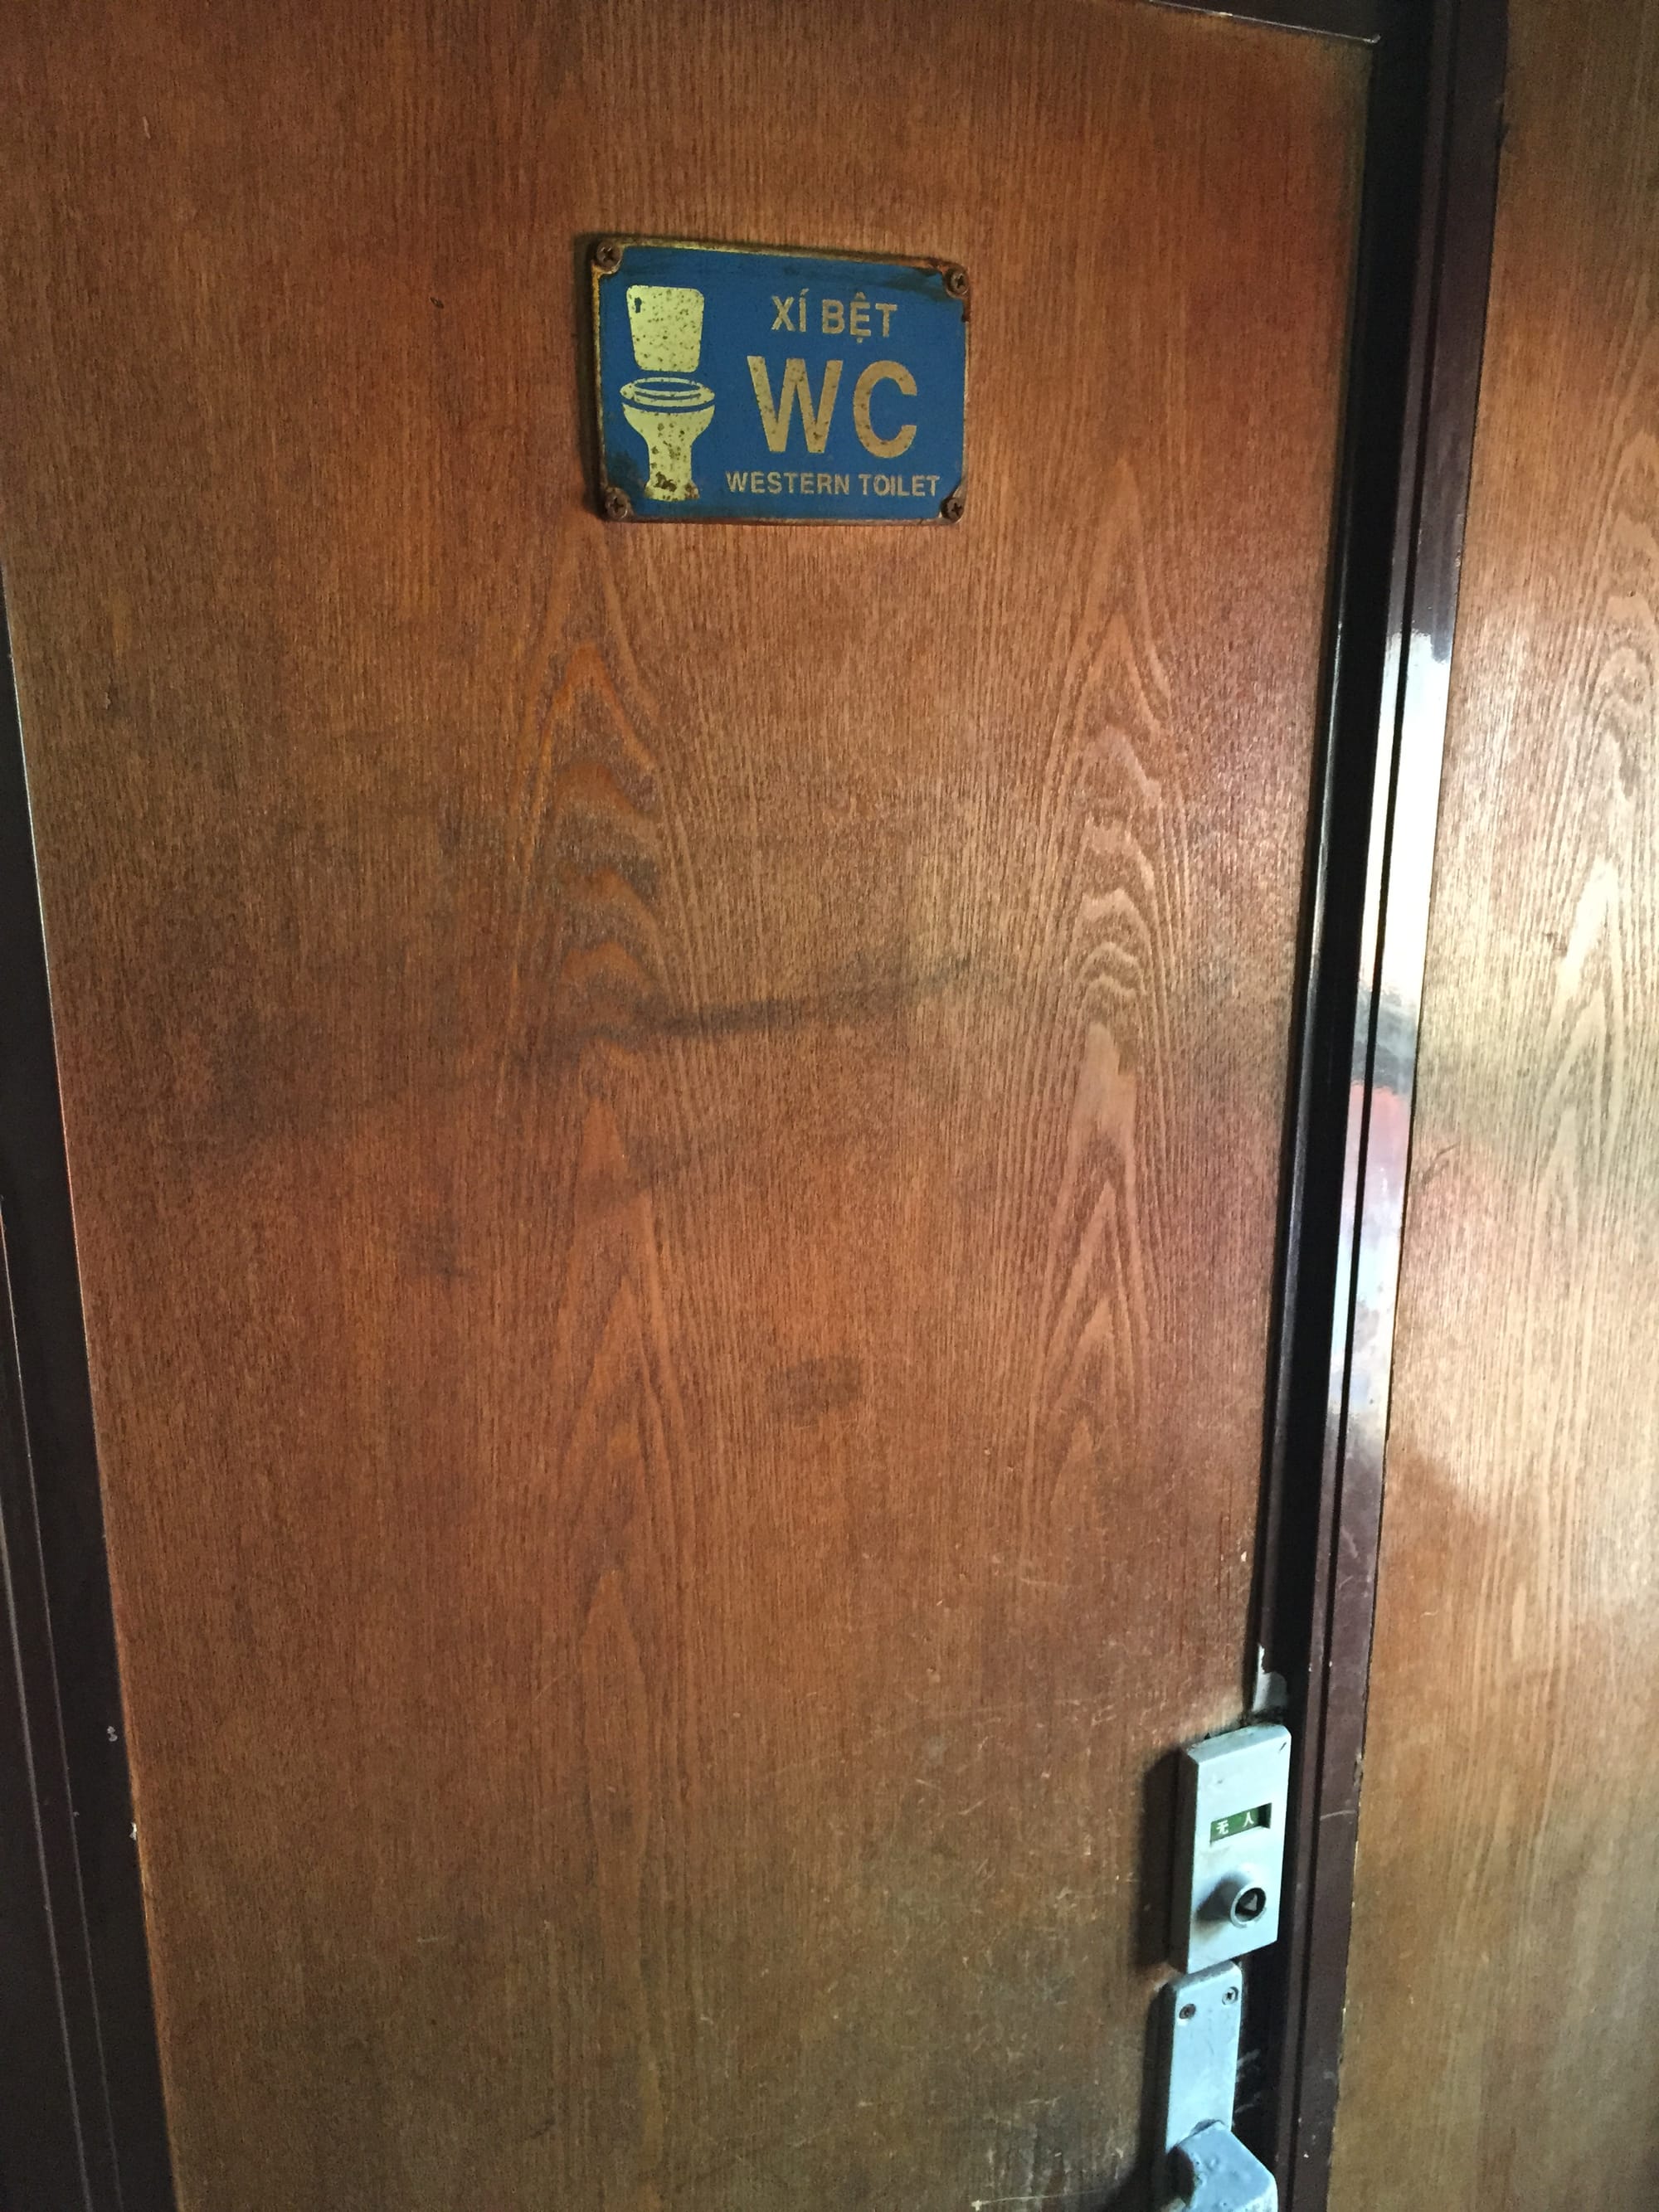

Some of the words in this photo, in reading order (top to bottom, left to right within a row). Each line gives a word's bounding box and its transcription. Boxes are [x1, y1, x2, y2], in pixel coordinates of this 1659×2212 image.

[771, 288, 809, 332] XÍ
[821, 291, 898, 343] BỆT
[747, 355, 917, 459] WC
[725, 470, 850, 496] WESTERN
[859, 474, 940, 497] TOILET
[1216, 1811, 1254, 1835] 无人
